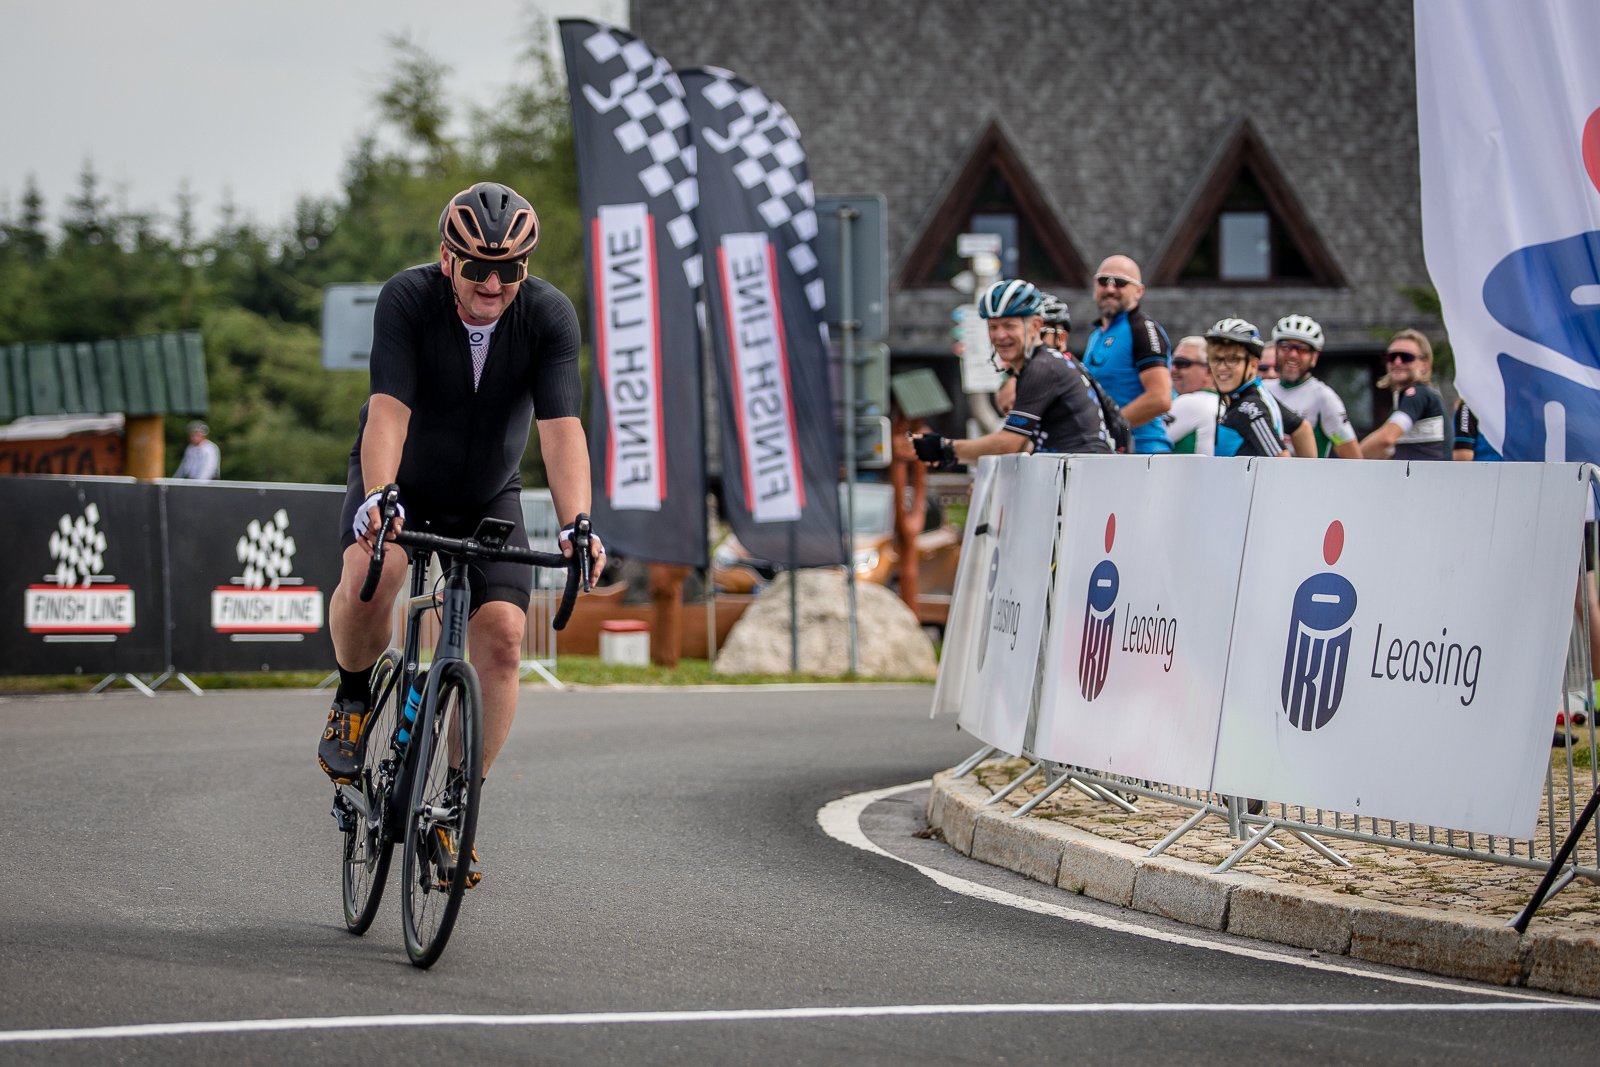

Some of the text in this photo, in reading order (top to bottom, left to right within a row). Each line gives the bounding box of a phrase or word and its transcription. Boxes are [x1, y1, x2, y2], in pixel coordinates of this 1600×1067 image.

[33, 595, 127, 623] FINISH LINE
[220, 596, 314, 623] FINISH LINE
[448, 598, 465, 649] BMC
[1122, 603, 1177, 673] Leasing
[1370, 623, 1482, 706] Leasing
